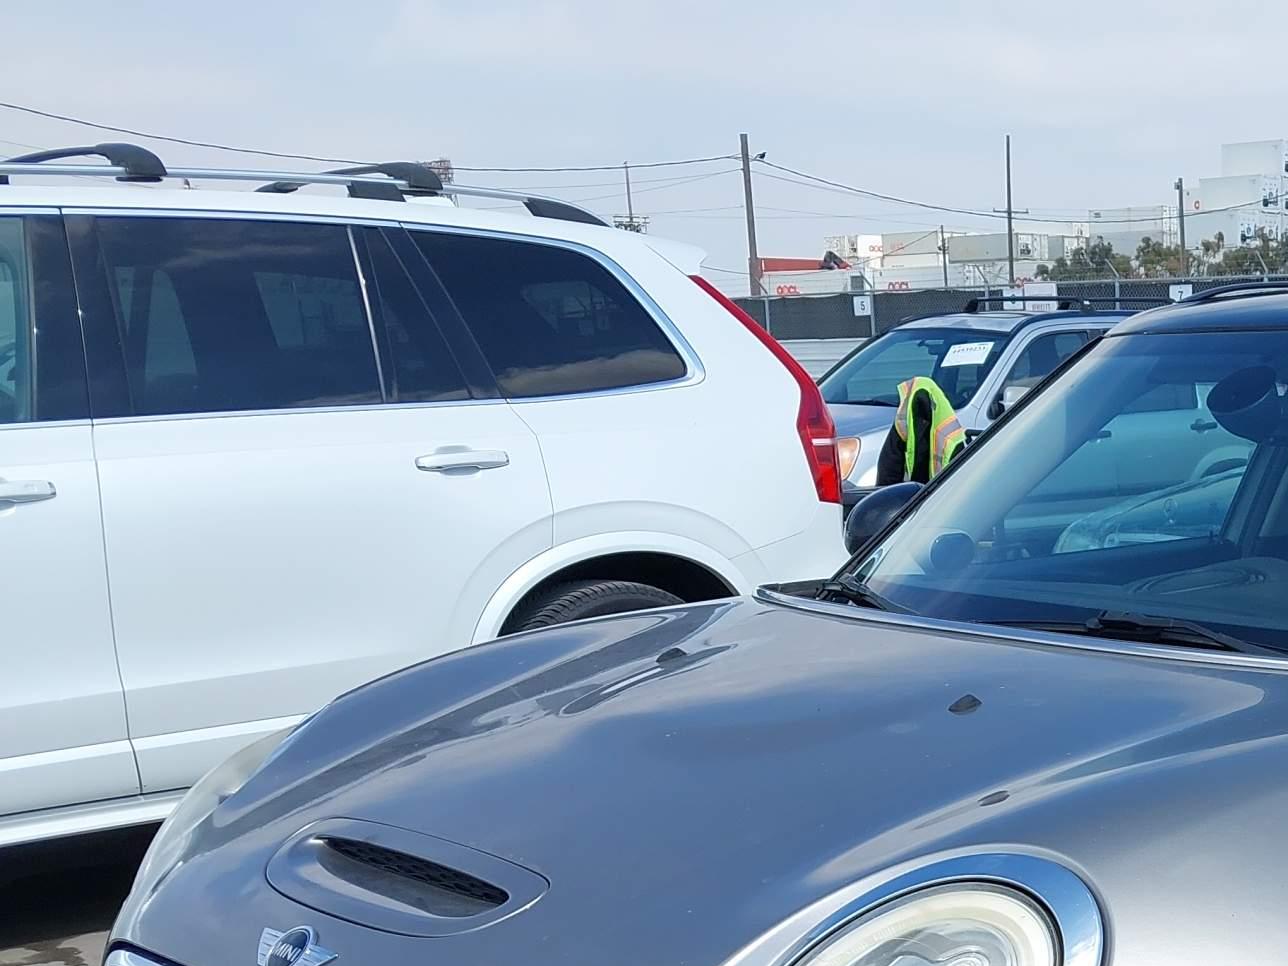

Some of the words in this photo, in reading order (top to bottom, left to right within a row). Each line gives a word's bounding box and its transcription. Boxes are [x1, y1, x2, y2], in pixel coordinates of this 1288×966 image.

[1178, 290, 1185, 300] 7
[860, 300, 866, 311] 5
[271, 940, 302, 962] MINI
